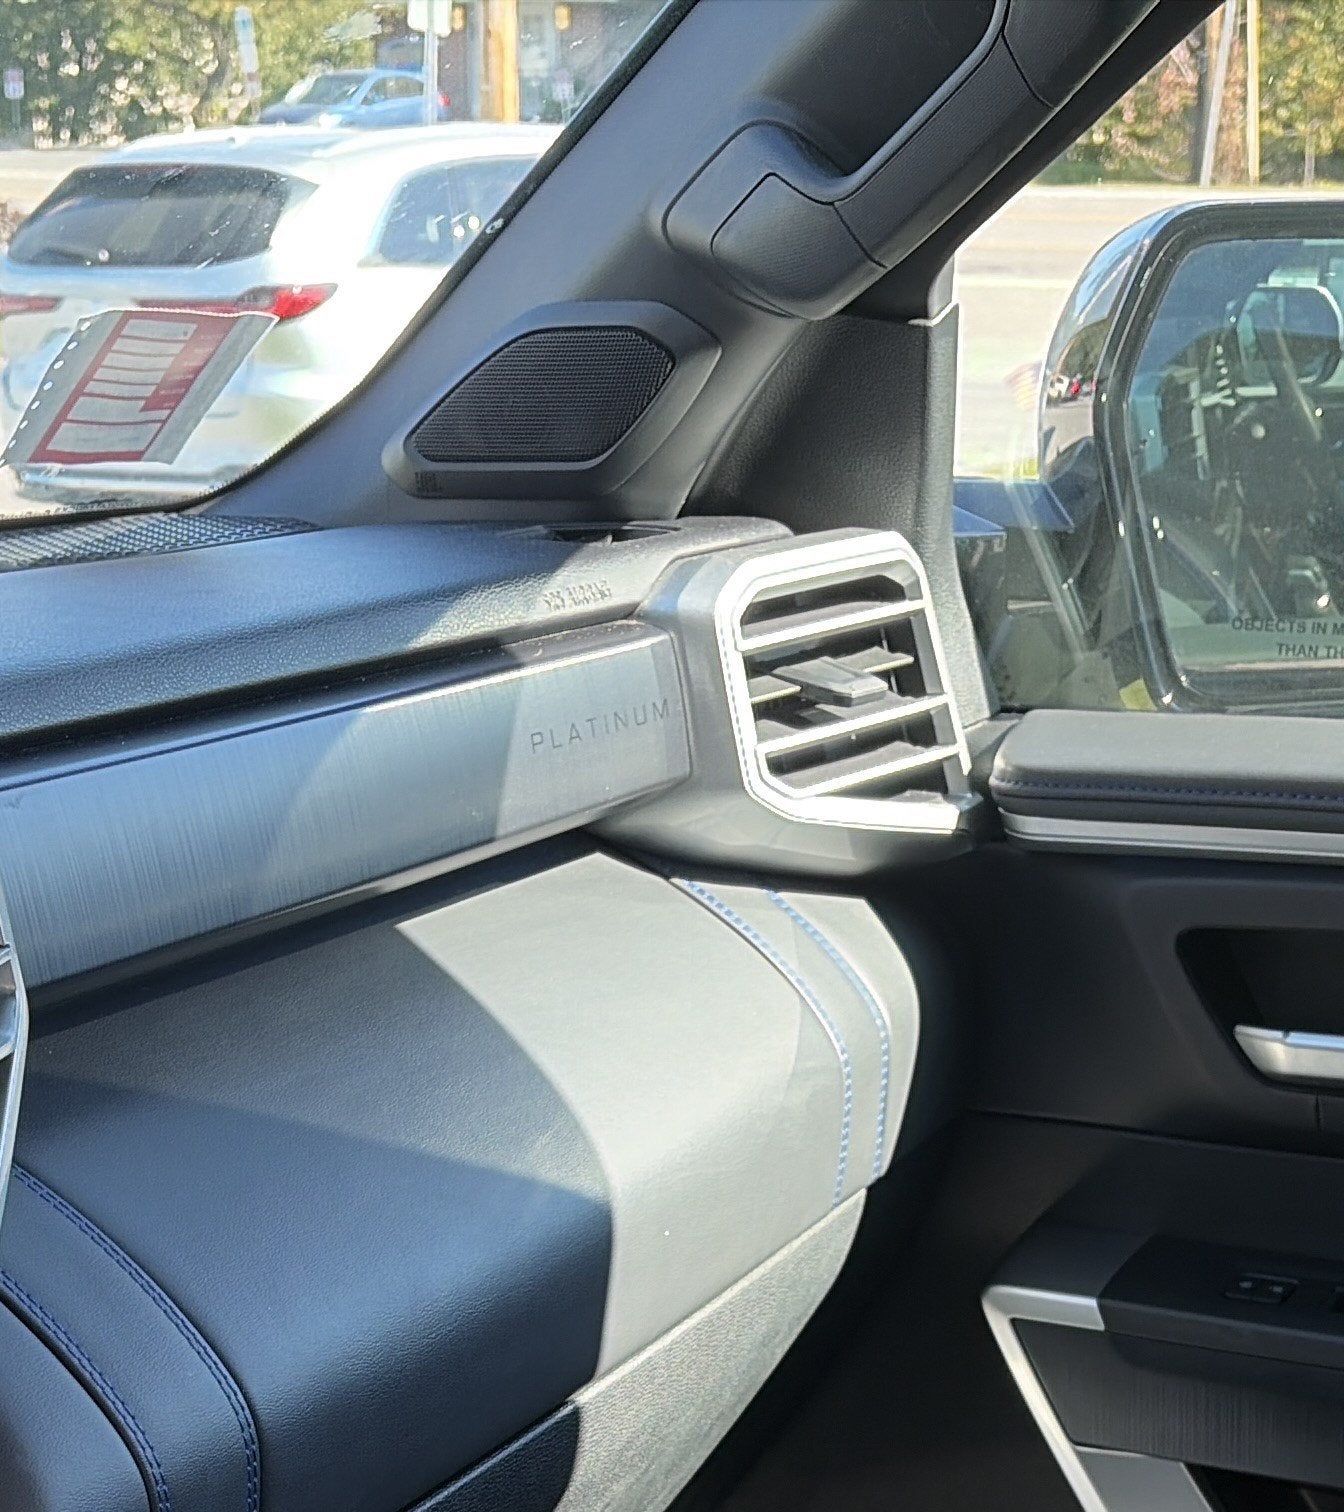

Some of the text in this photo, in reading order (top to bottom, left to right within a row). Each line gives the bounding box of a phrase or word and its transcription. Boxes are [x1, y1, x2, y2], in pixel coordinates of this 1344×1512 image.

[1231, 616, 1306, 636] OBJECTS
[1311, 619, 1327, 635] IN
[1276, 641, 1320, 659] THAN
[530, 698, 672, 754] PLATINUM
